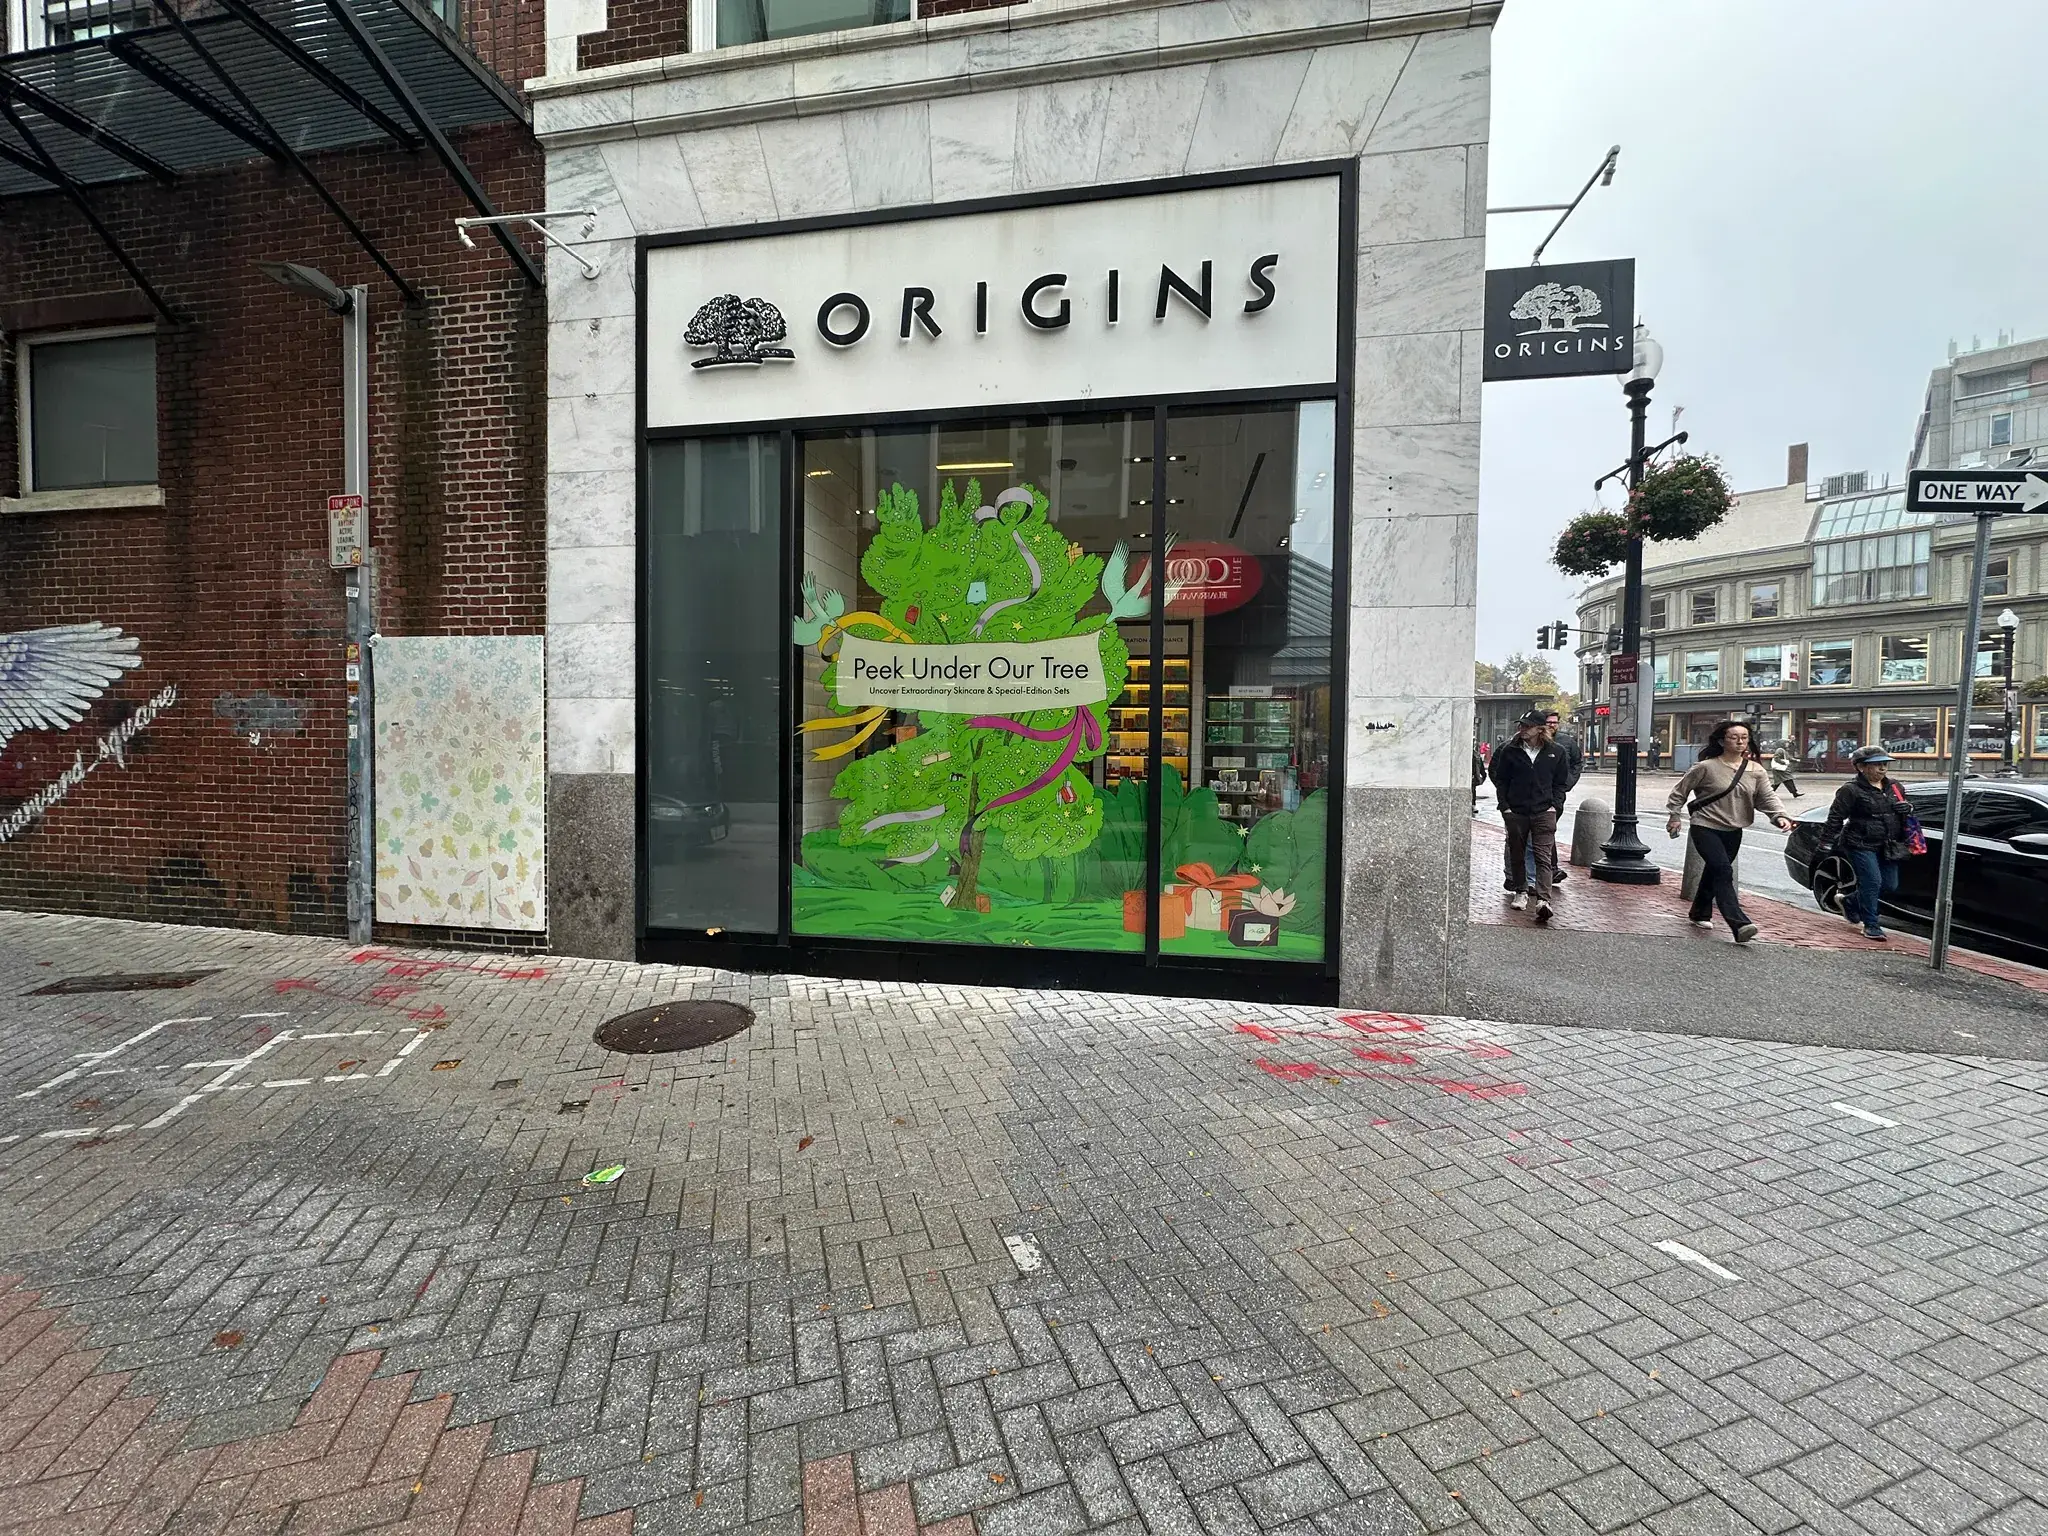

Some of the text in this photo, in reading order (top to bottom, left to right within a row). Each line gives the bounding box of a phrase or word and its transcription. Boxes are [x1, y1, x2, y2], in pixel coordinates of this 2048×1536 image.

[816, 253, 1278, 347] ORIGINS
[1494, 335, 1624, 358] ORIGINS
[1924, 483, 2021, 501] ONE WAY
[853, 655, 1089, 680] Peek Under Our Tree
[1613, 666, 1635, 674] Harvard
[869, 686, 1070, 697] Uncover Extraordinary Skincare & Special-Edition Sets
